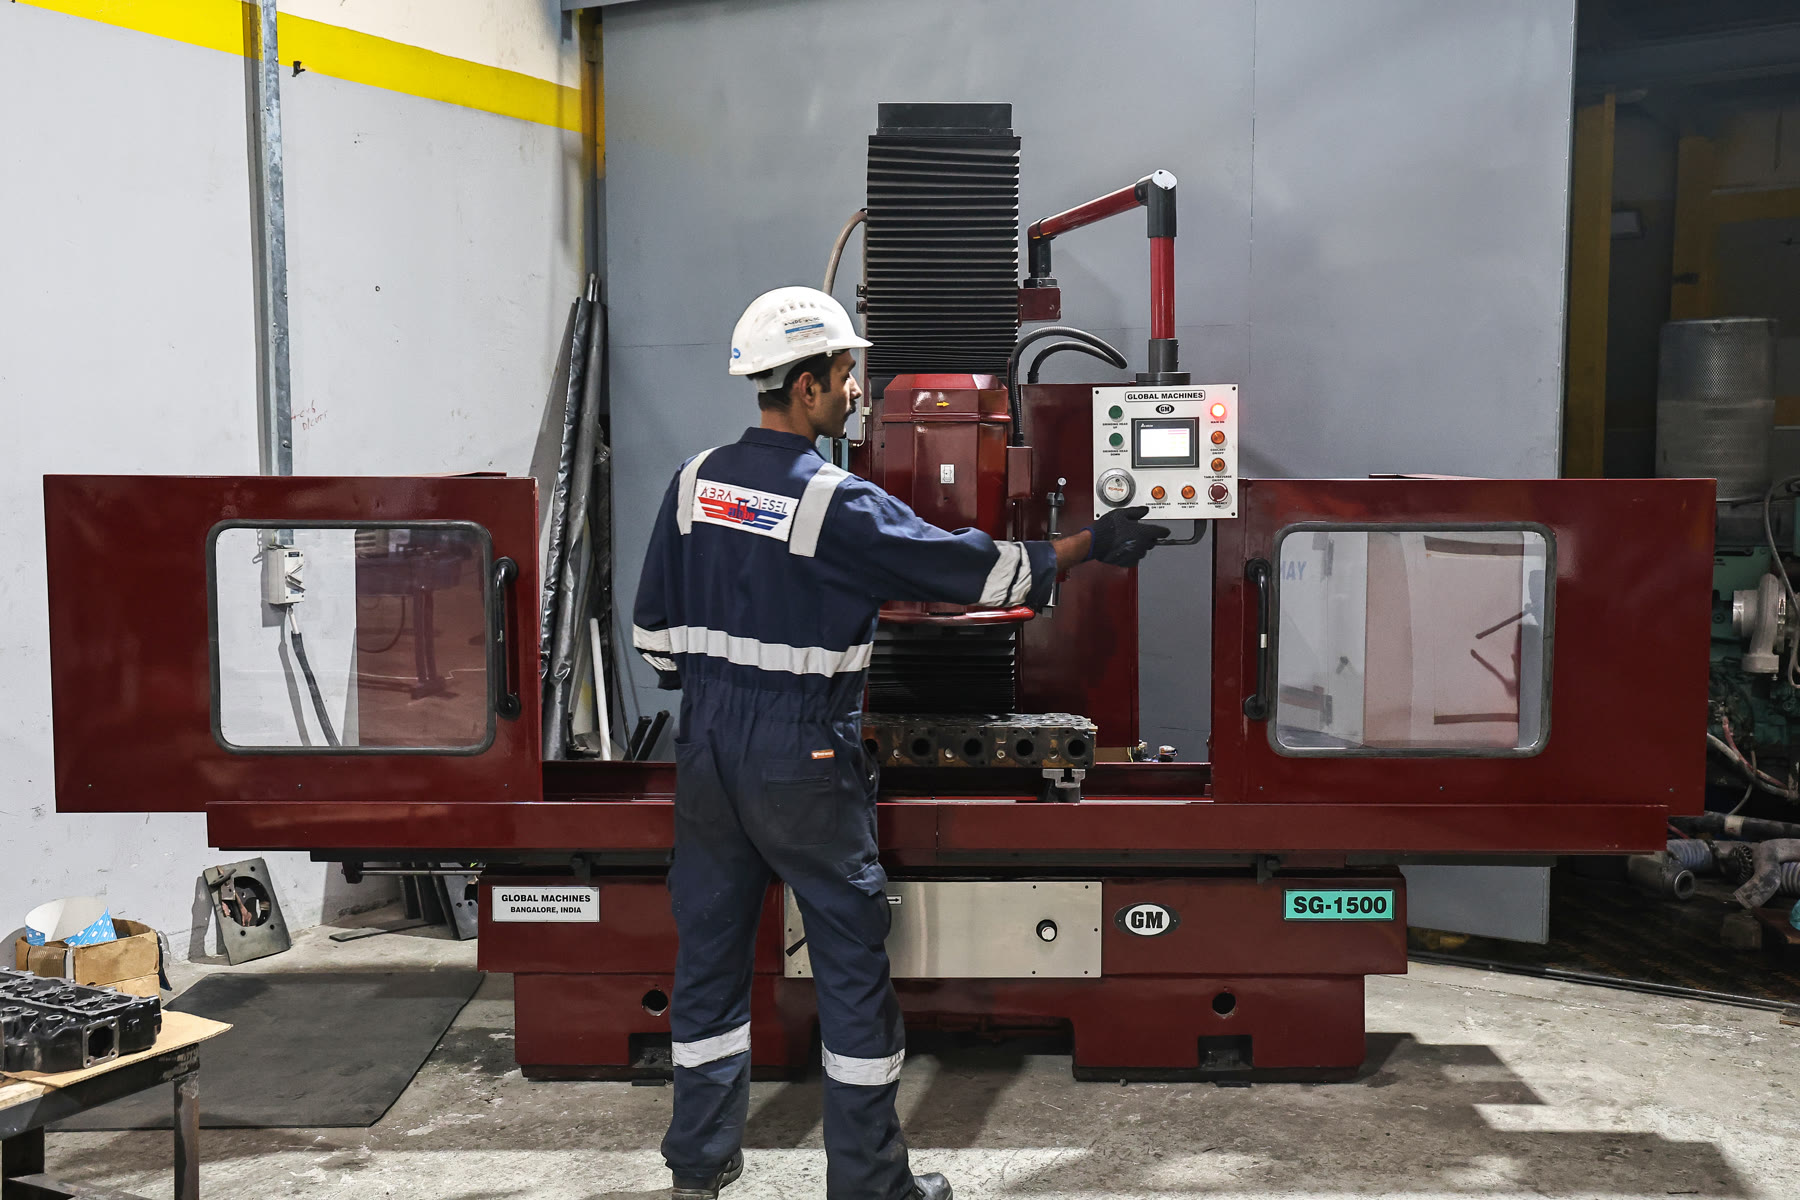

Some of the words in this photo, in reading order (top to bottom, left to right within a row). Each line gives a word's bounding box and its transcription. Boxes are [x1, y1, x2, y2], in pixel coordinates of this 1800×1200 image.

[1161, 392, 1203, 400] MACHINES
[700, 486, 732, 502] ABRA
[751, 496, 788, 514] DIESEL
[501, 894, 538, 902] GLOBAL
[541, 894, 591, 902] MACHINES
[510, 906, 558, 914] BANGALORE,
[1293, 896, 1387, 914] SG-1500
[1130, 910, 1164, 929] GM
